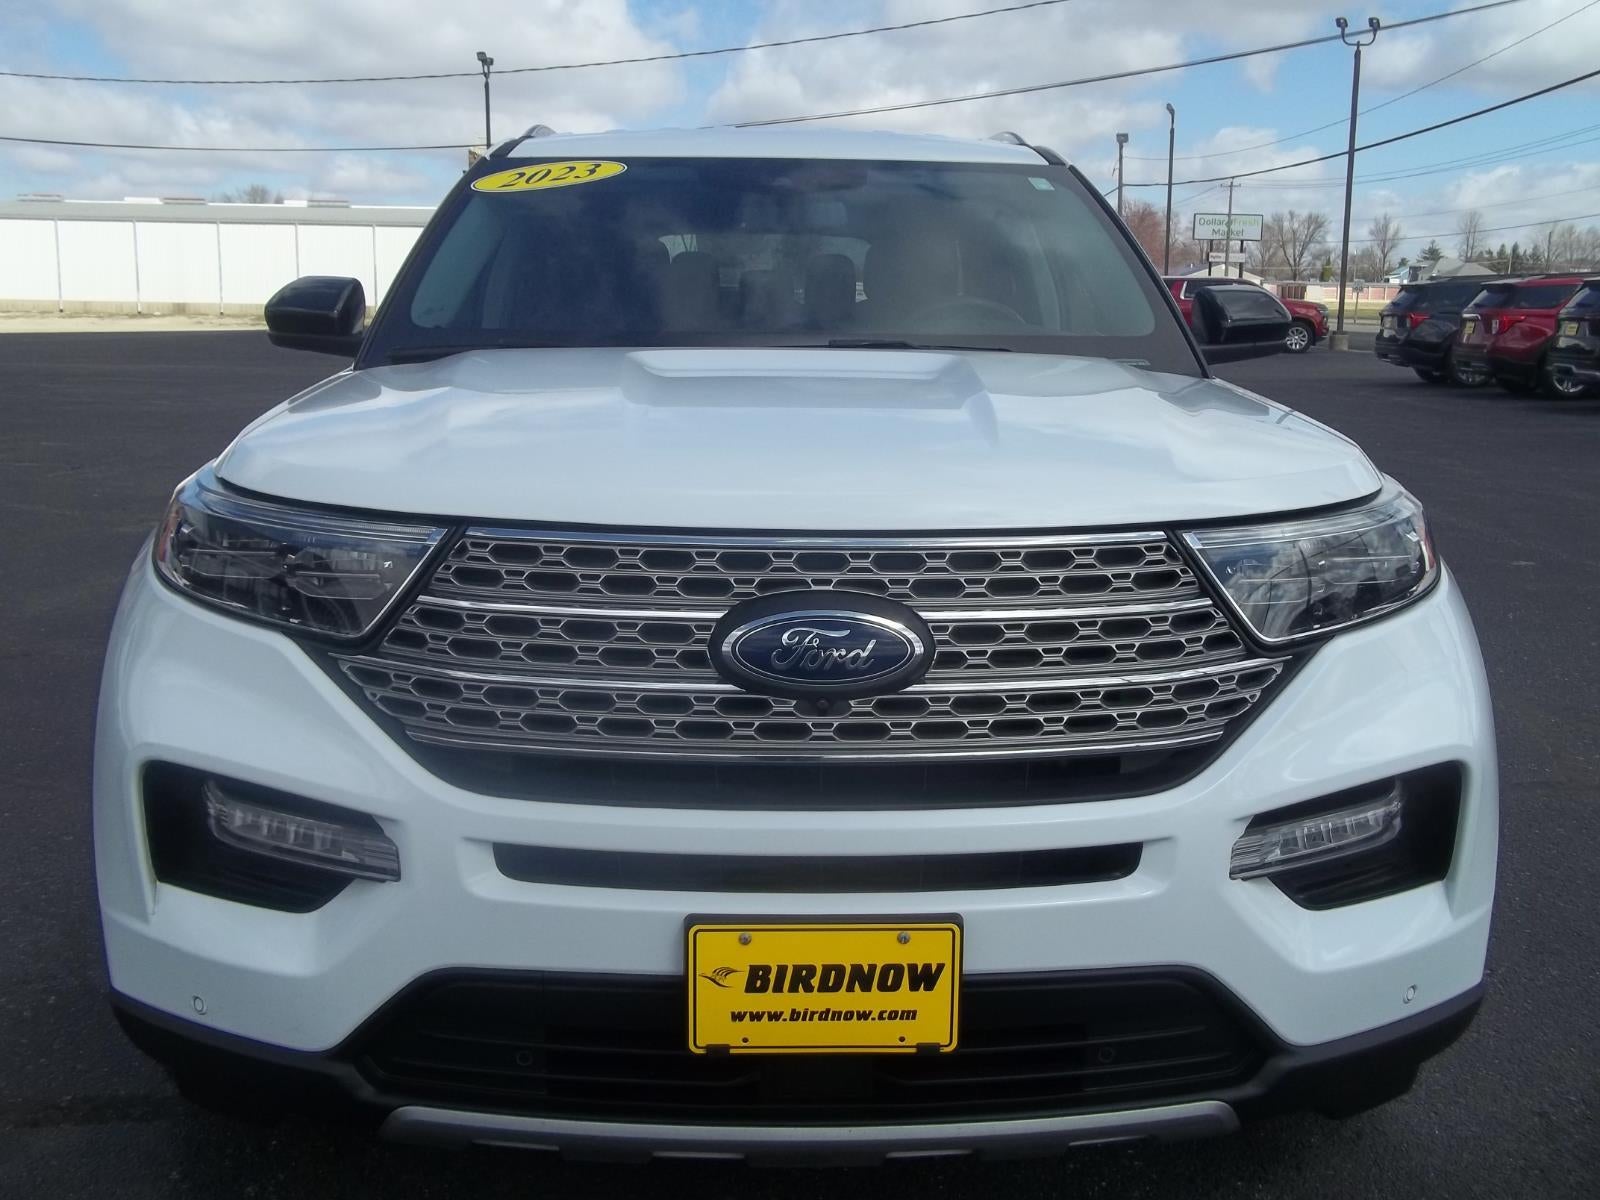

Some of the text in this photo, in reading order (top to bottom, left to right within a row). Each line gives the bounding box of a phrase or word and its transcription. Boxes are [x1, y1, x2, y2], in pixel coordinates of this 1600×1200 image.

[497, 163, 603, 189] 2023
[1198, 217, 1226, 226] Dollar
[770, 627, 877, 671] Ford
[744, 963, 946, 994] BIRDNOW
[730, 1007, 918, 1022] www.birdnow.com
